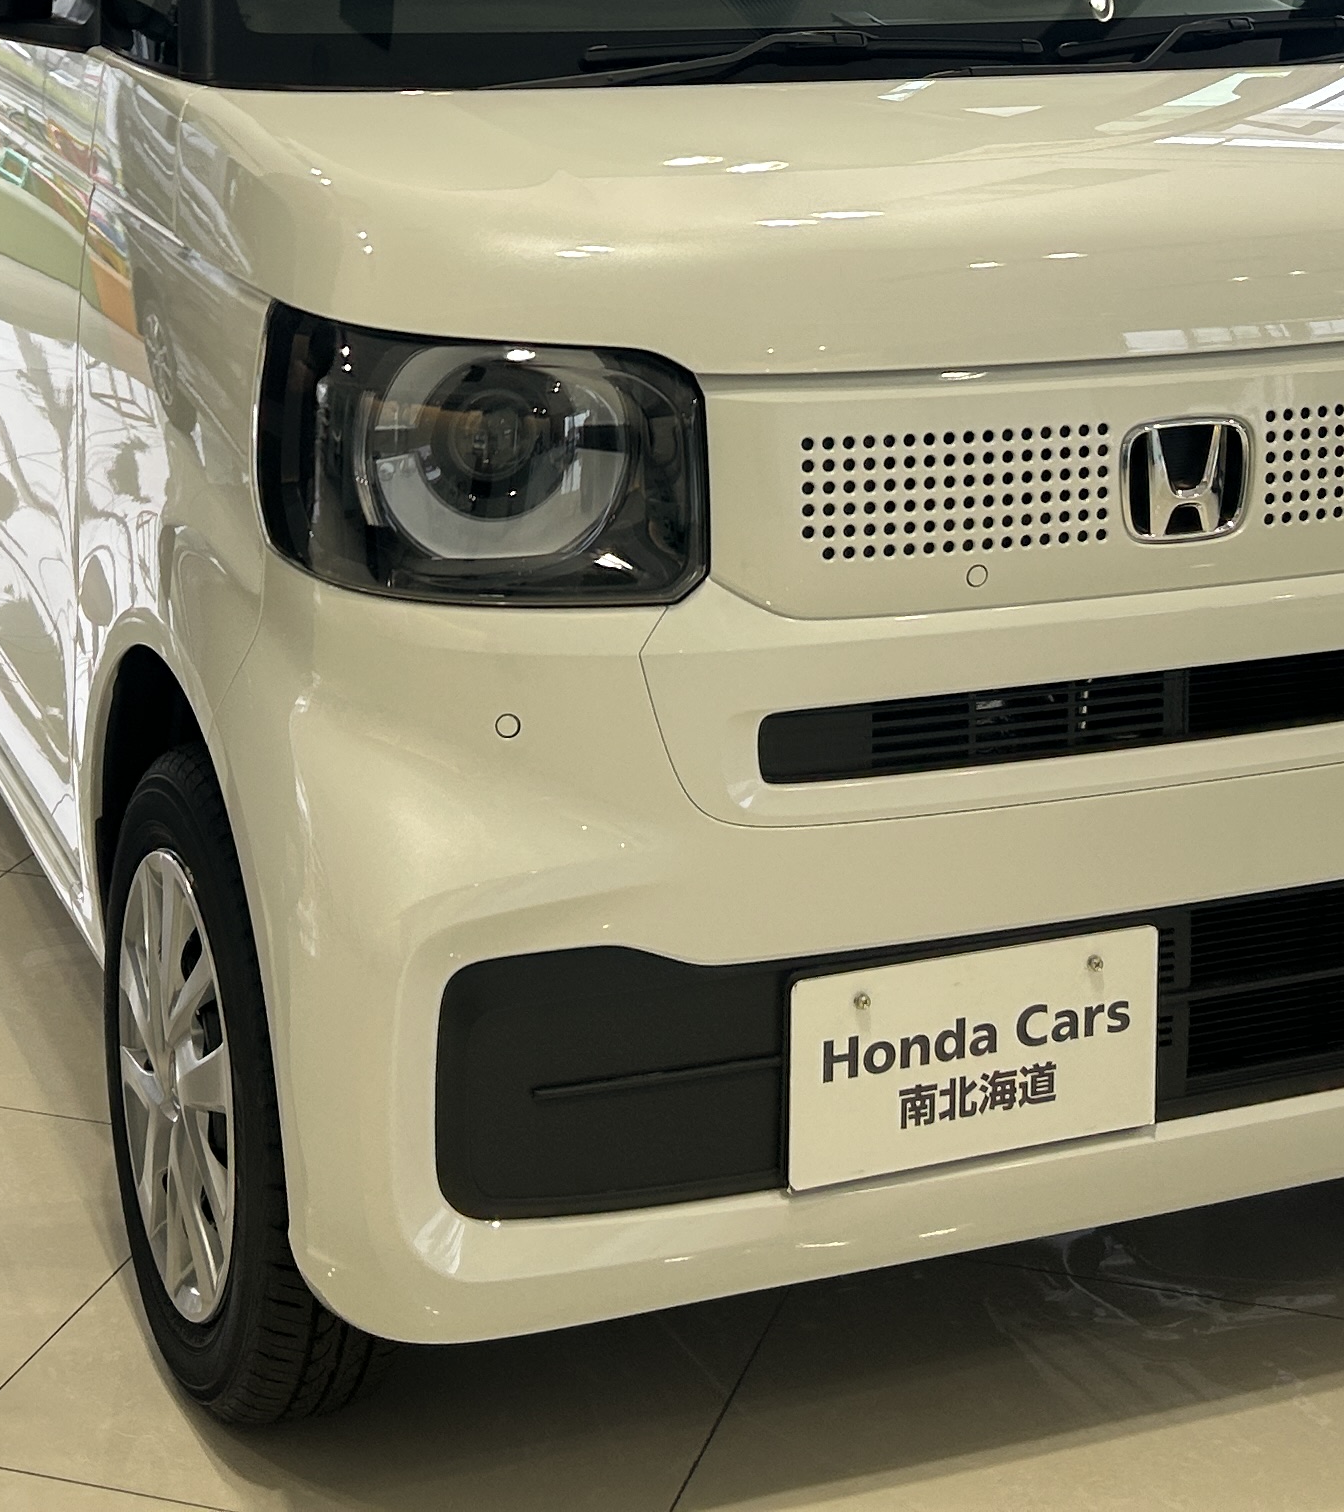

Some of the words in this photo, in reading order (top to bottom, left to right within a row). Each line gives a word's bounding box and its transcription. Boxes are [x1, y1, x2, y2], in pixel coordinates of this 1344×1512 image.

[822, 1017, 998, 1084] Honda
[1015, 999, 1132, 1048] Cars
[898, 1061, 1058, 1130] 南北海道
